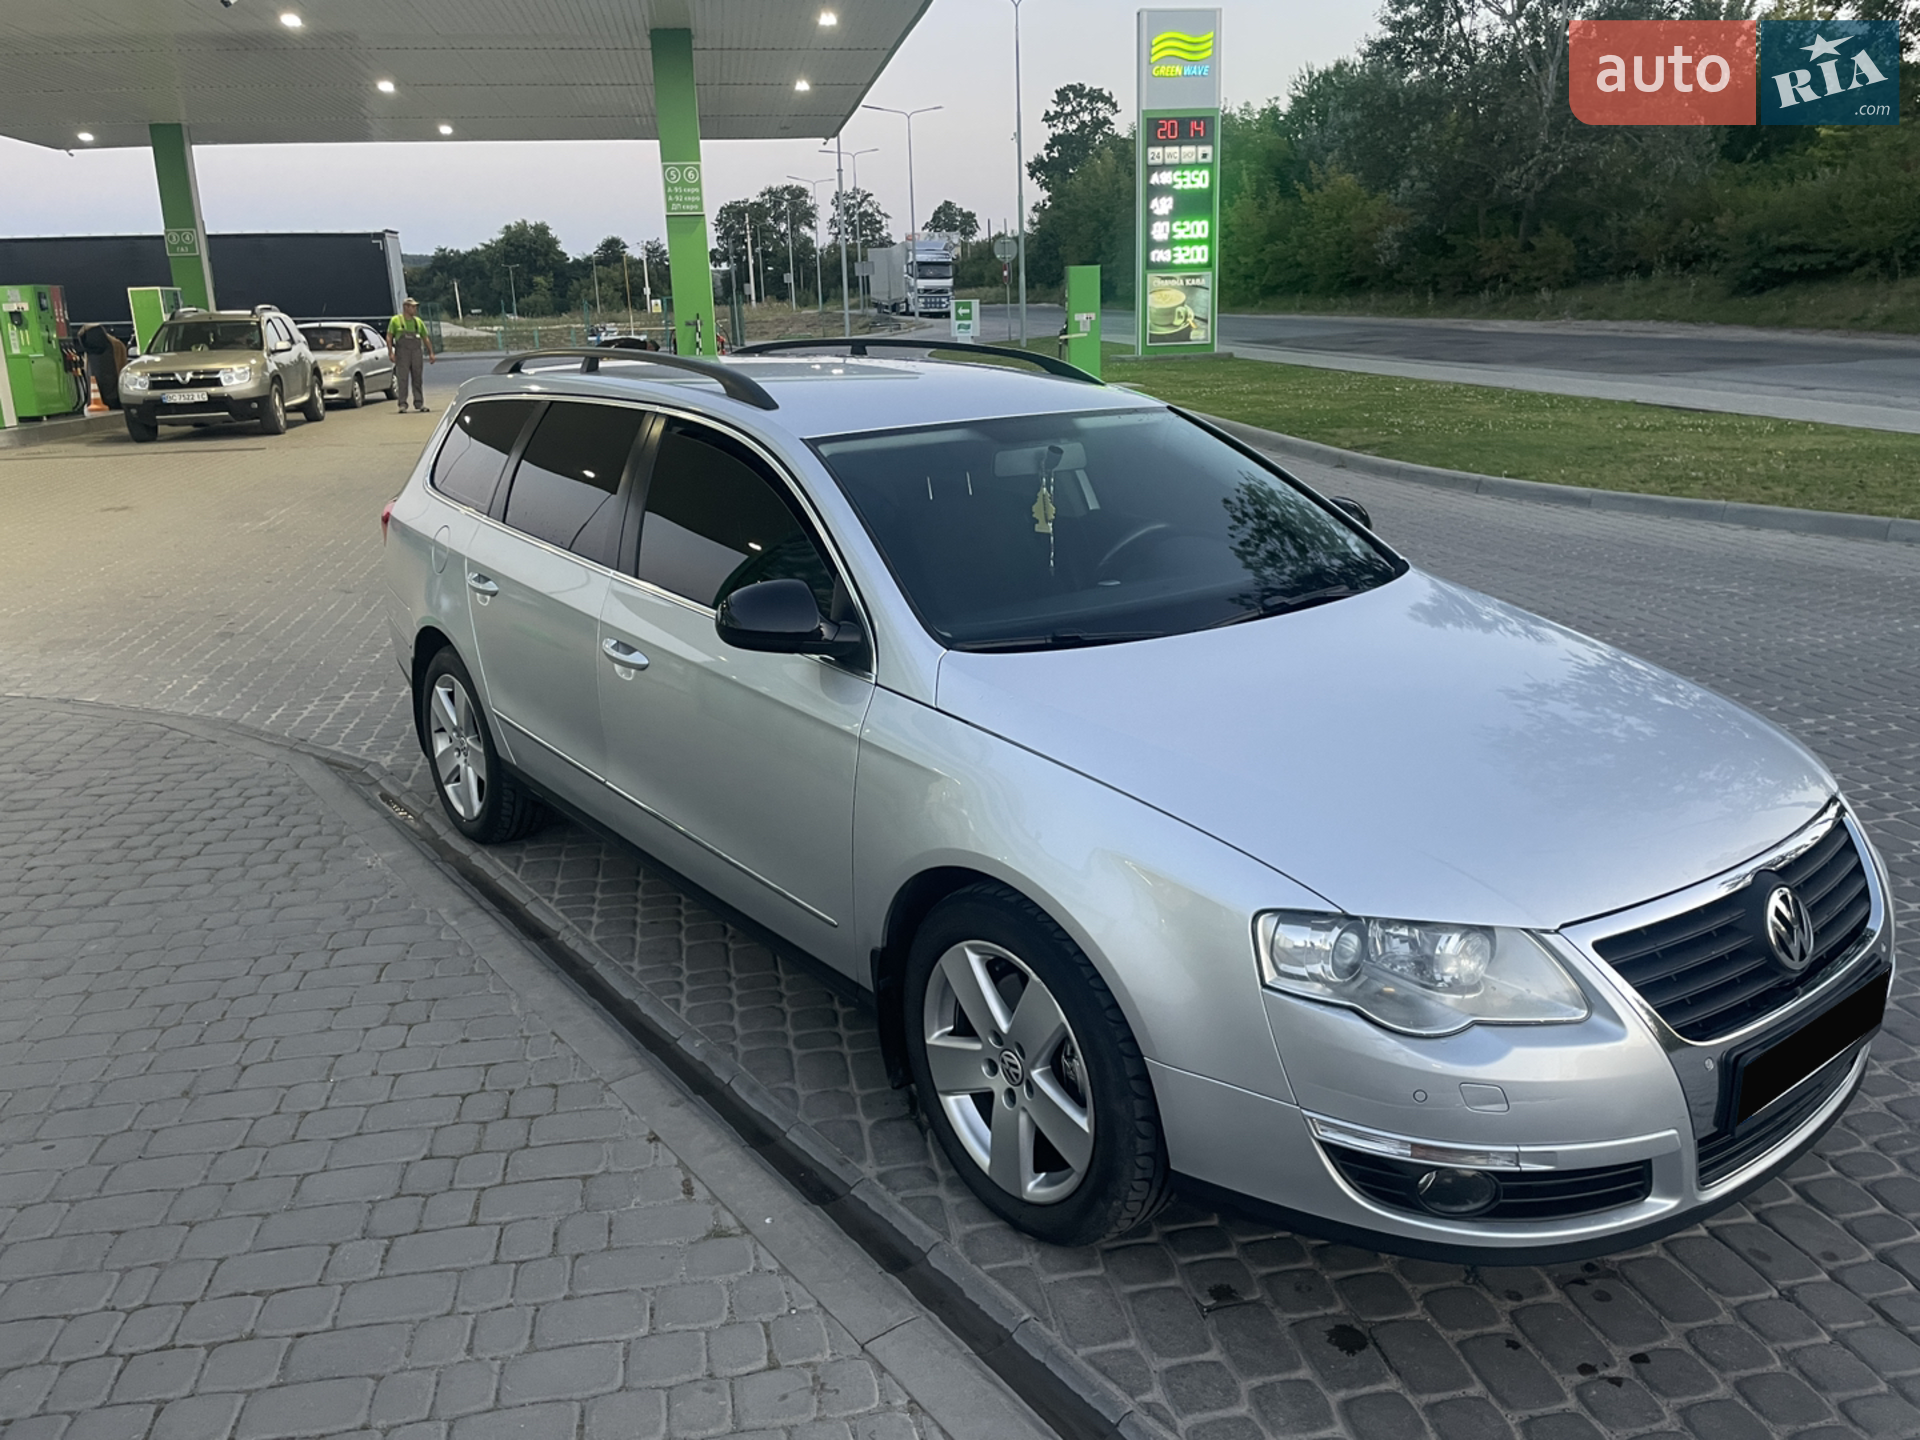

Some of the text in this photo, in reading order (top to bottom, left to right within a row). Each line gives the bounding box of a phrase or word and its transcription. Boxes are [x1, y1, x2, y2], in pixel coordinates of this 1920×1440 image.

[1152, 65, 1209, 77] GREEN WAVE
[1166, 151, 1178, 160] WC
